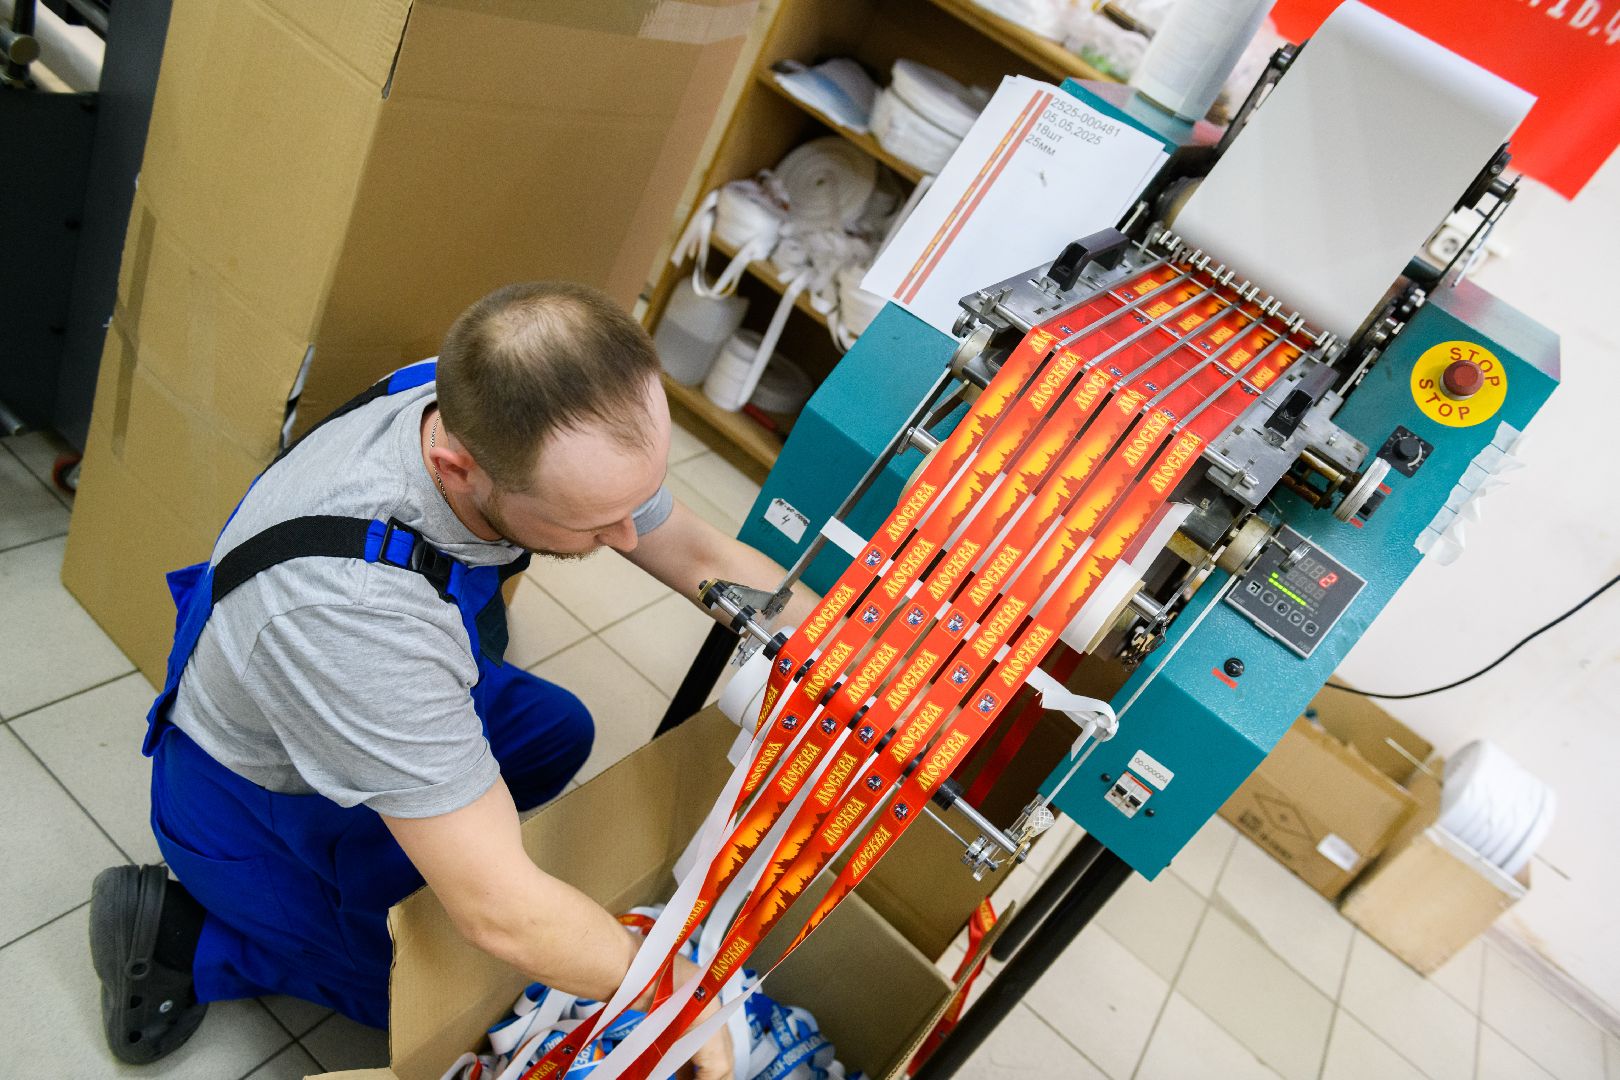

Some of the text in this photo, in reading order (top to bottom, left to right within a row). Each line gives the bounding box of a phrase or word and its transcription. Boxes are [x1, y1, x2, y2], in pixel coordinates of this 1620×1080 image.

[1036, 122, 1064, 143] 18шт
[1041, 110, 1104, 146] 05.05.2025
[1050, 97, 1121, 137] 2525-000481
[1450, 347, 1500, 387] STOP
[1419, 378, 1470, 420] STOP
[886, 481, 937, 543] МОСКВА
[883, 537, 936, 599] МОСКВА
[927, 538, 980, 600] МОСКВА
[968, 544, 1022, 606] МОСКВА
[804, 583, 855, 643] МОСКВА
[972, 595, 1027, 659] МОСКВА
[803, 640, 855, 701] МОСКВА
[845, 642, 898, 704] МОСКВА
[885, 649, 939, 711] МОСКВА
[999, 624, 1053, 687] МОСКВА
[890, 700, 943, 763] МОСКВА
[915, 729, 969, 792] МОСКВА
[777, 741, 822, 795] МОСКВА
[814, 751, 858, 806] МОСКВА
[821, 796, 867, 846] МОСКВА
[852, 824, 892, 879] МОСКВА
[710, 936, 751, 981] МОСКВА
